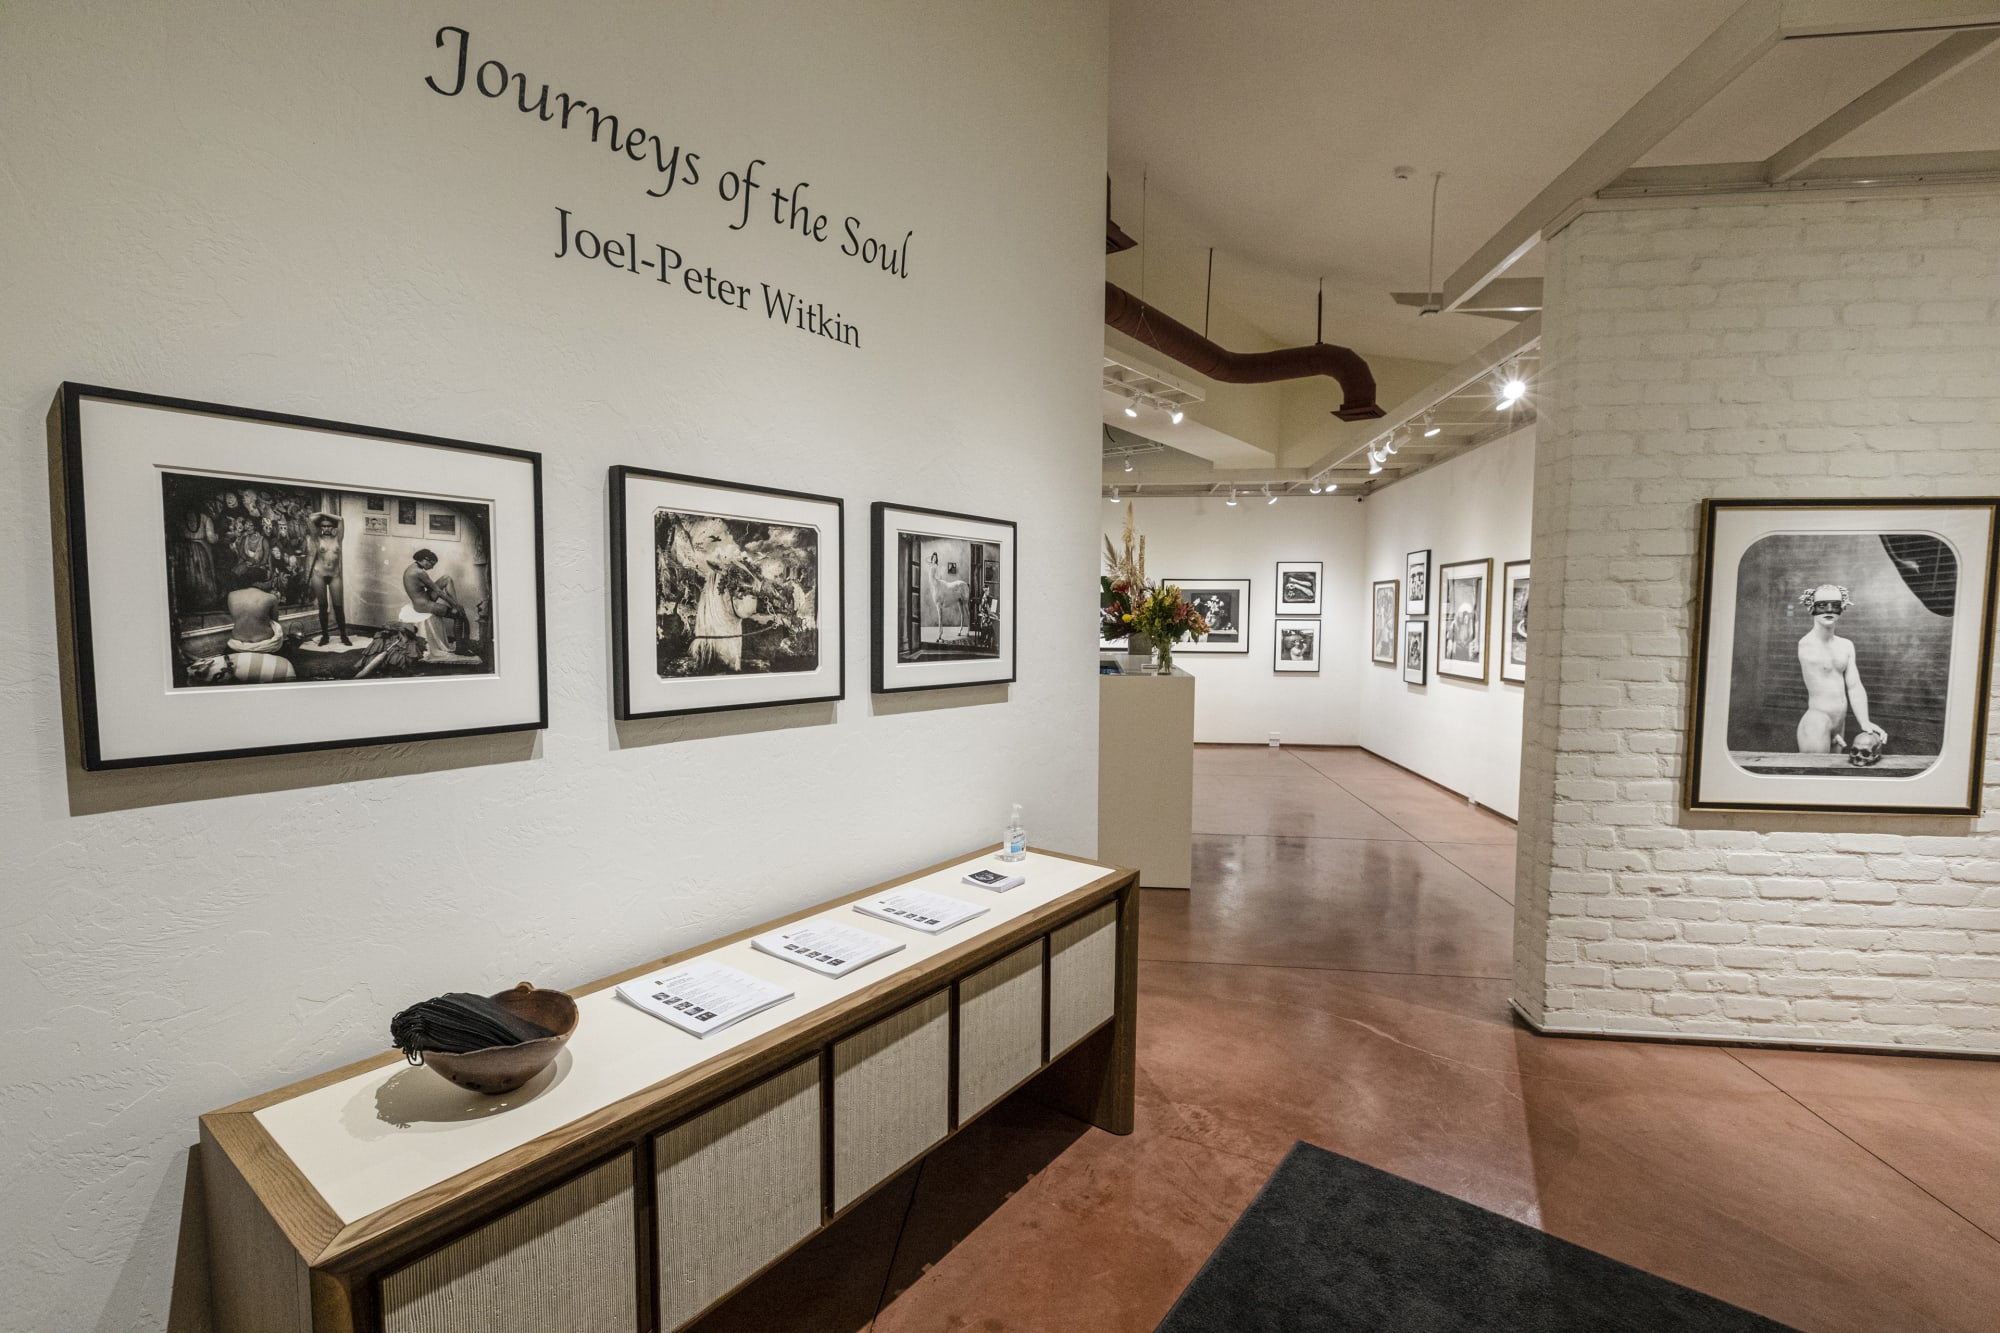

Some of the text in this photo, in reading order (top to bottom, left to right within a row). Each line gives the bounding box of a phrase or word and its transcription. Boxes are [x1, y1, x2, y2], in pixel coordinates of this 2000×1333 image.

[424, 25, 913, 280] Journeys of the Soul
[554, 206, 862, 349] Joel-Peter Witkin
